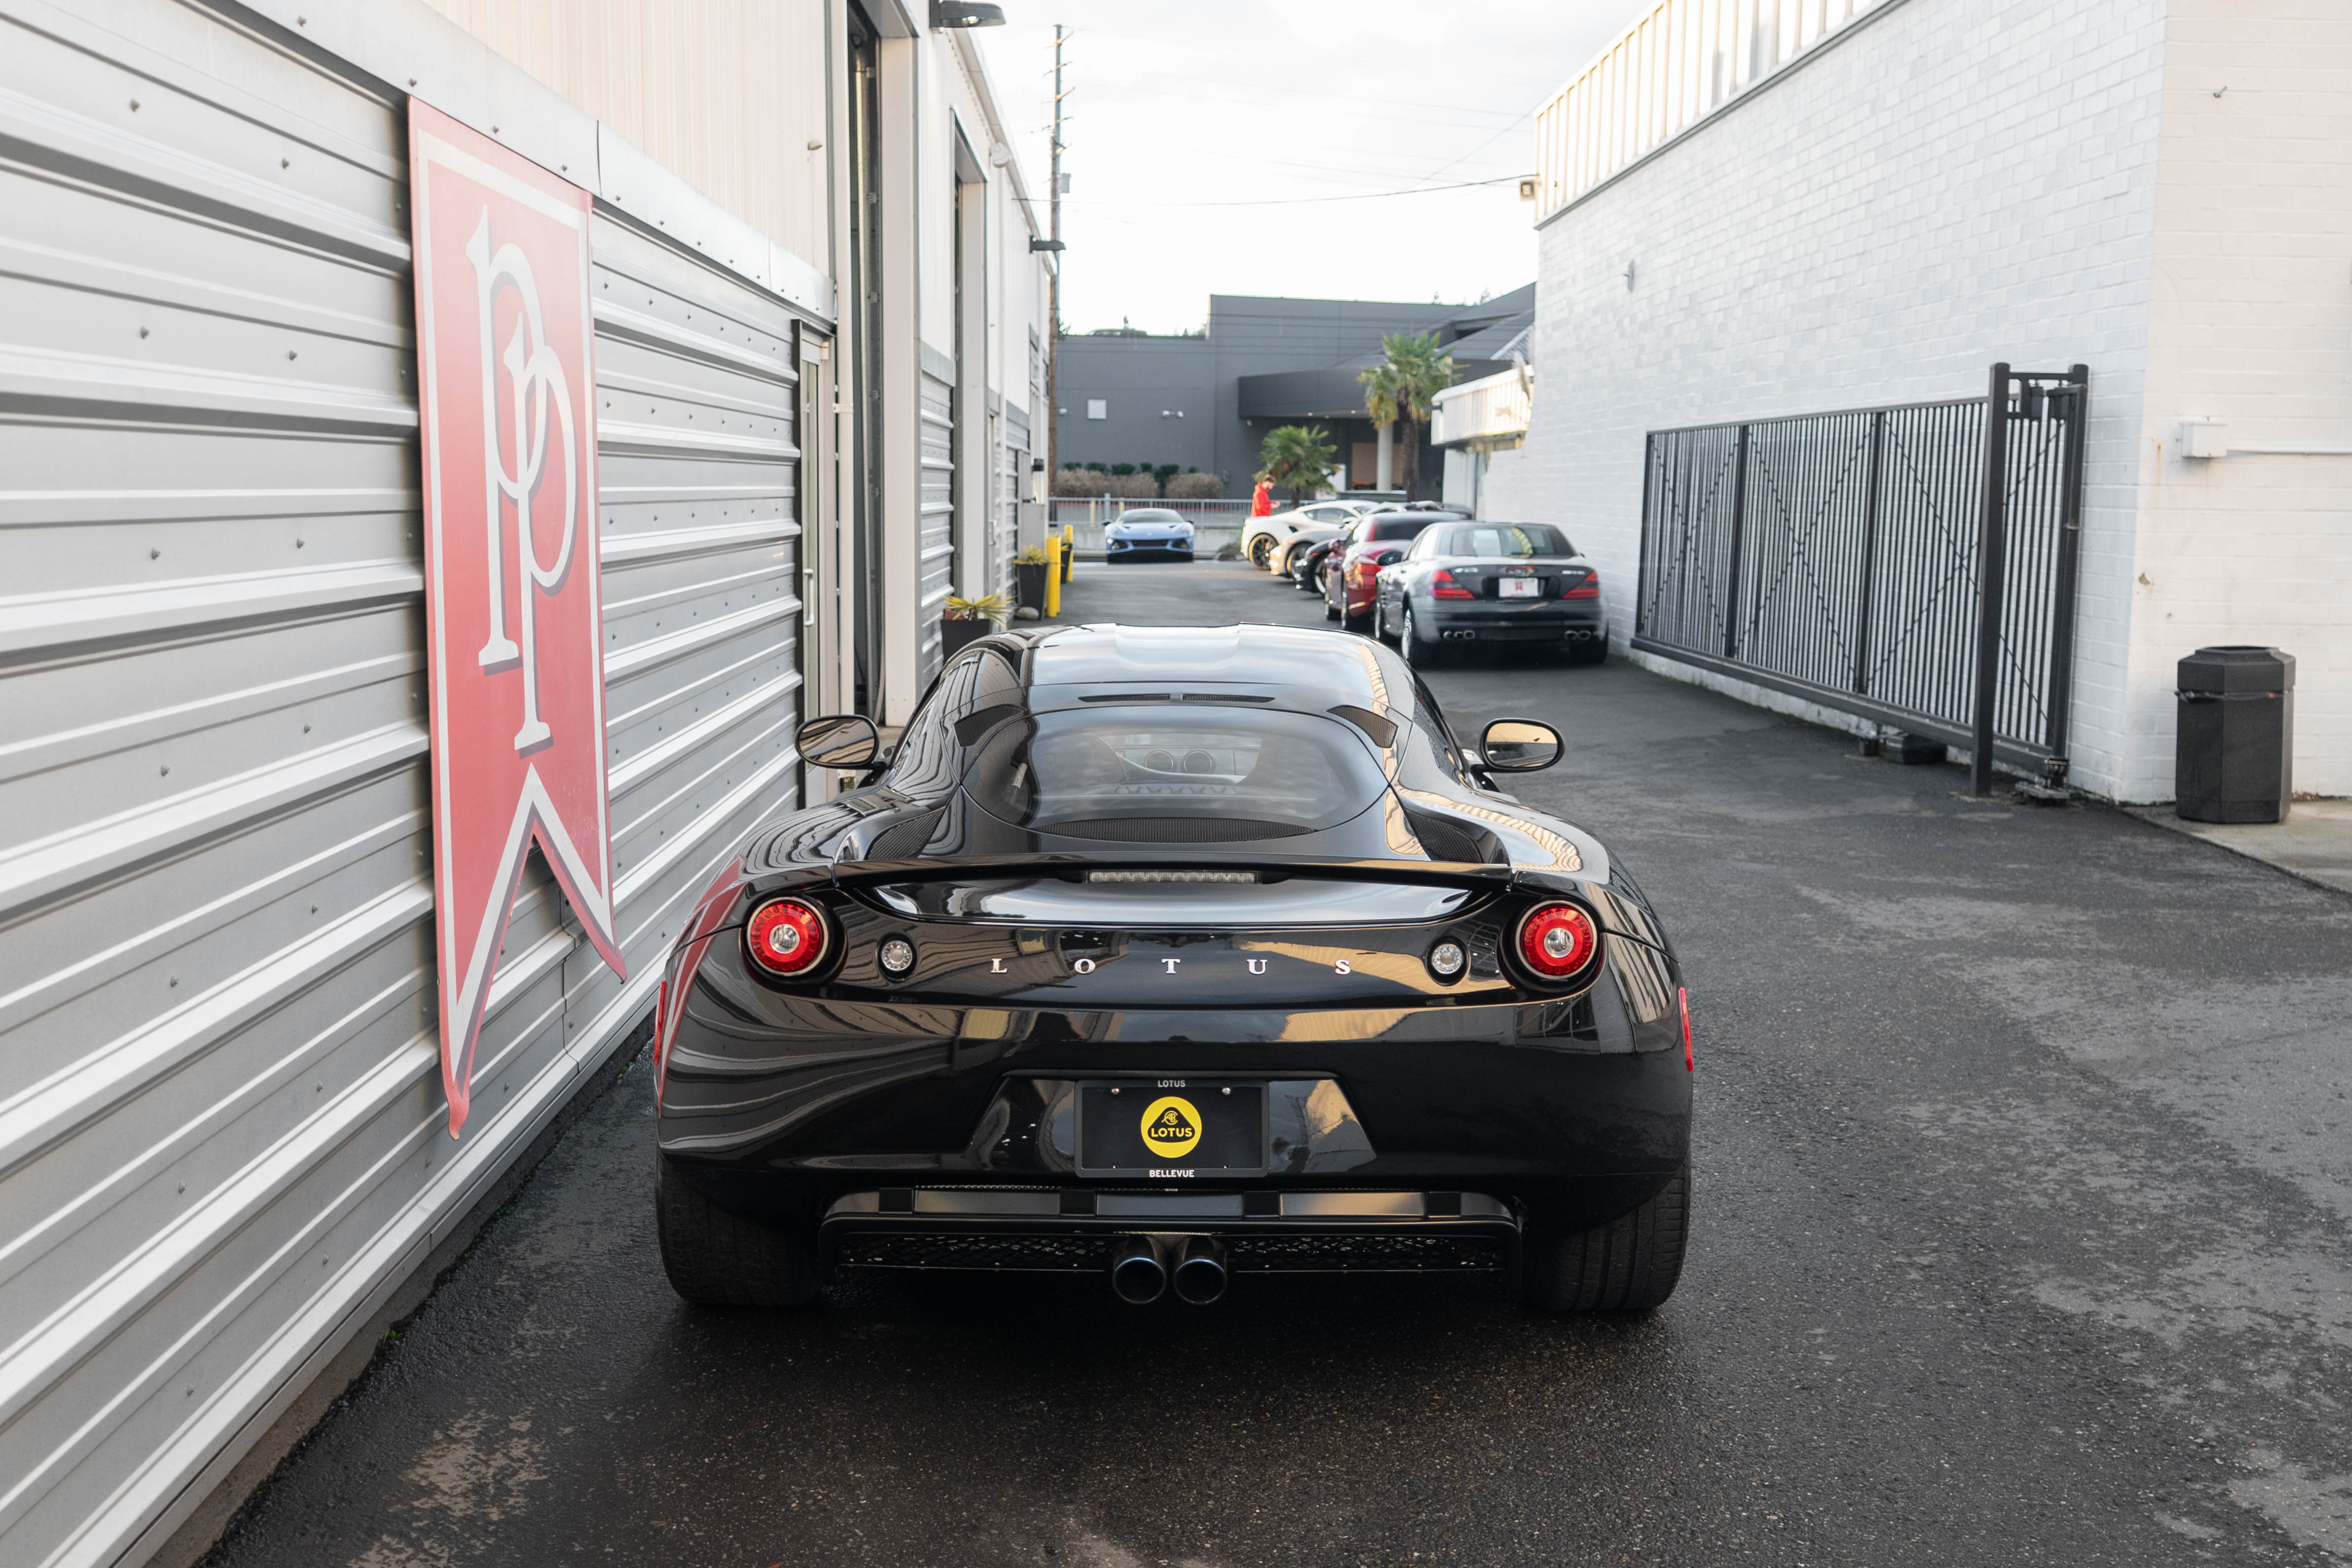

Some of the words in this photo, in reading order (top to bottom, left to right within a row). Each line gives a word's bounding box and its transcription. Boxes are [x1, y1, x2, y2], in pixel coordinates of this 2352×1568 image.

[990, 958, 1352, 975] LOTUS
[1157, 1080, 1186, 1088] LOTUS
[1151, 1127, 1193, 1138] LOTUS
[1149, 1169, 1194, 1178] BELLEVUE
